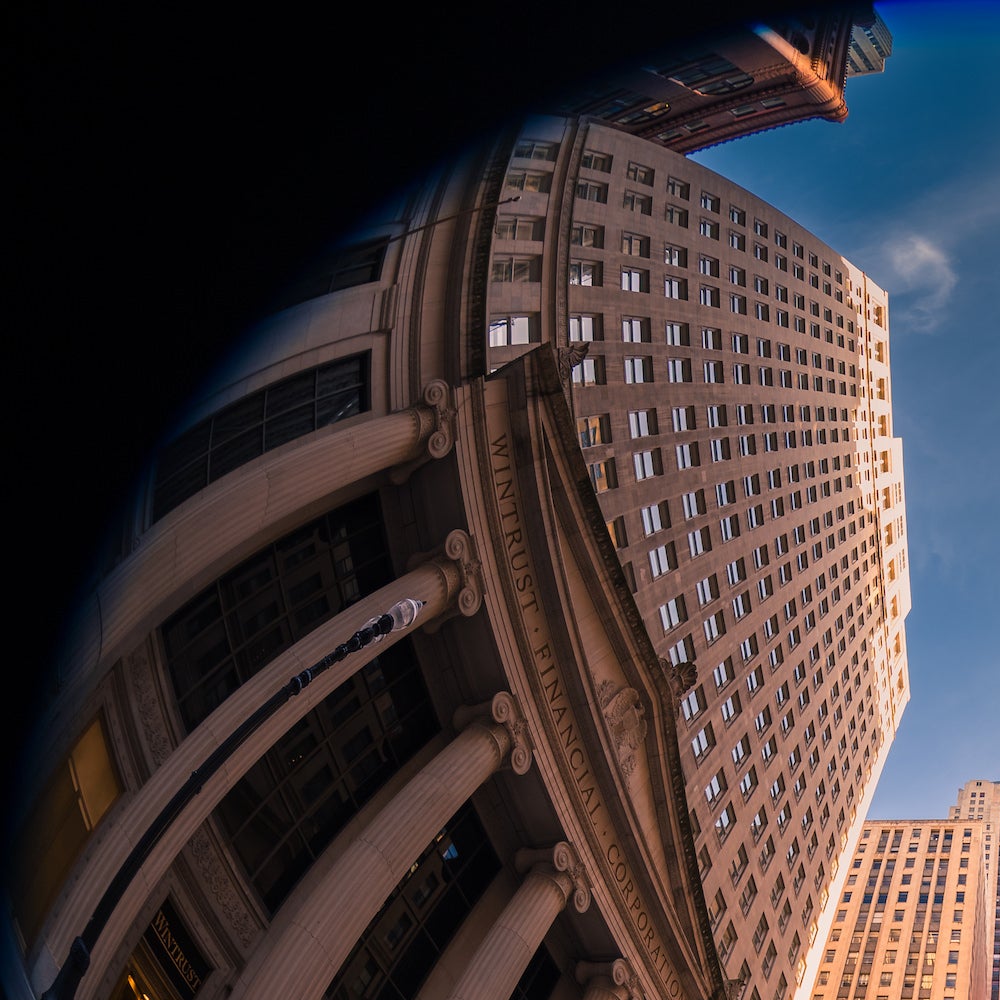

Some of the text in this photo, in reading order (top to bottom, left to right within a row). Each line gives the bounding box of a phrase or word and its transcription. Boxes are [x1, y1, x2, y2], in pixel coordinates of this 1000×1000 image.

[491, 434, 539, 613] WINTRUST
[534, 643, 602, 826] FINANCIAL
[155, 910, 202, 990] WINTRUST
